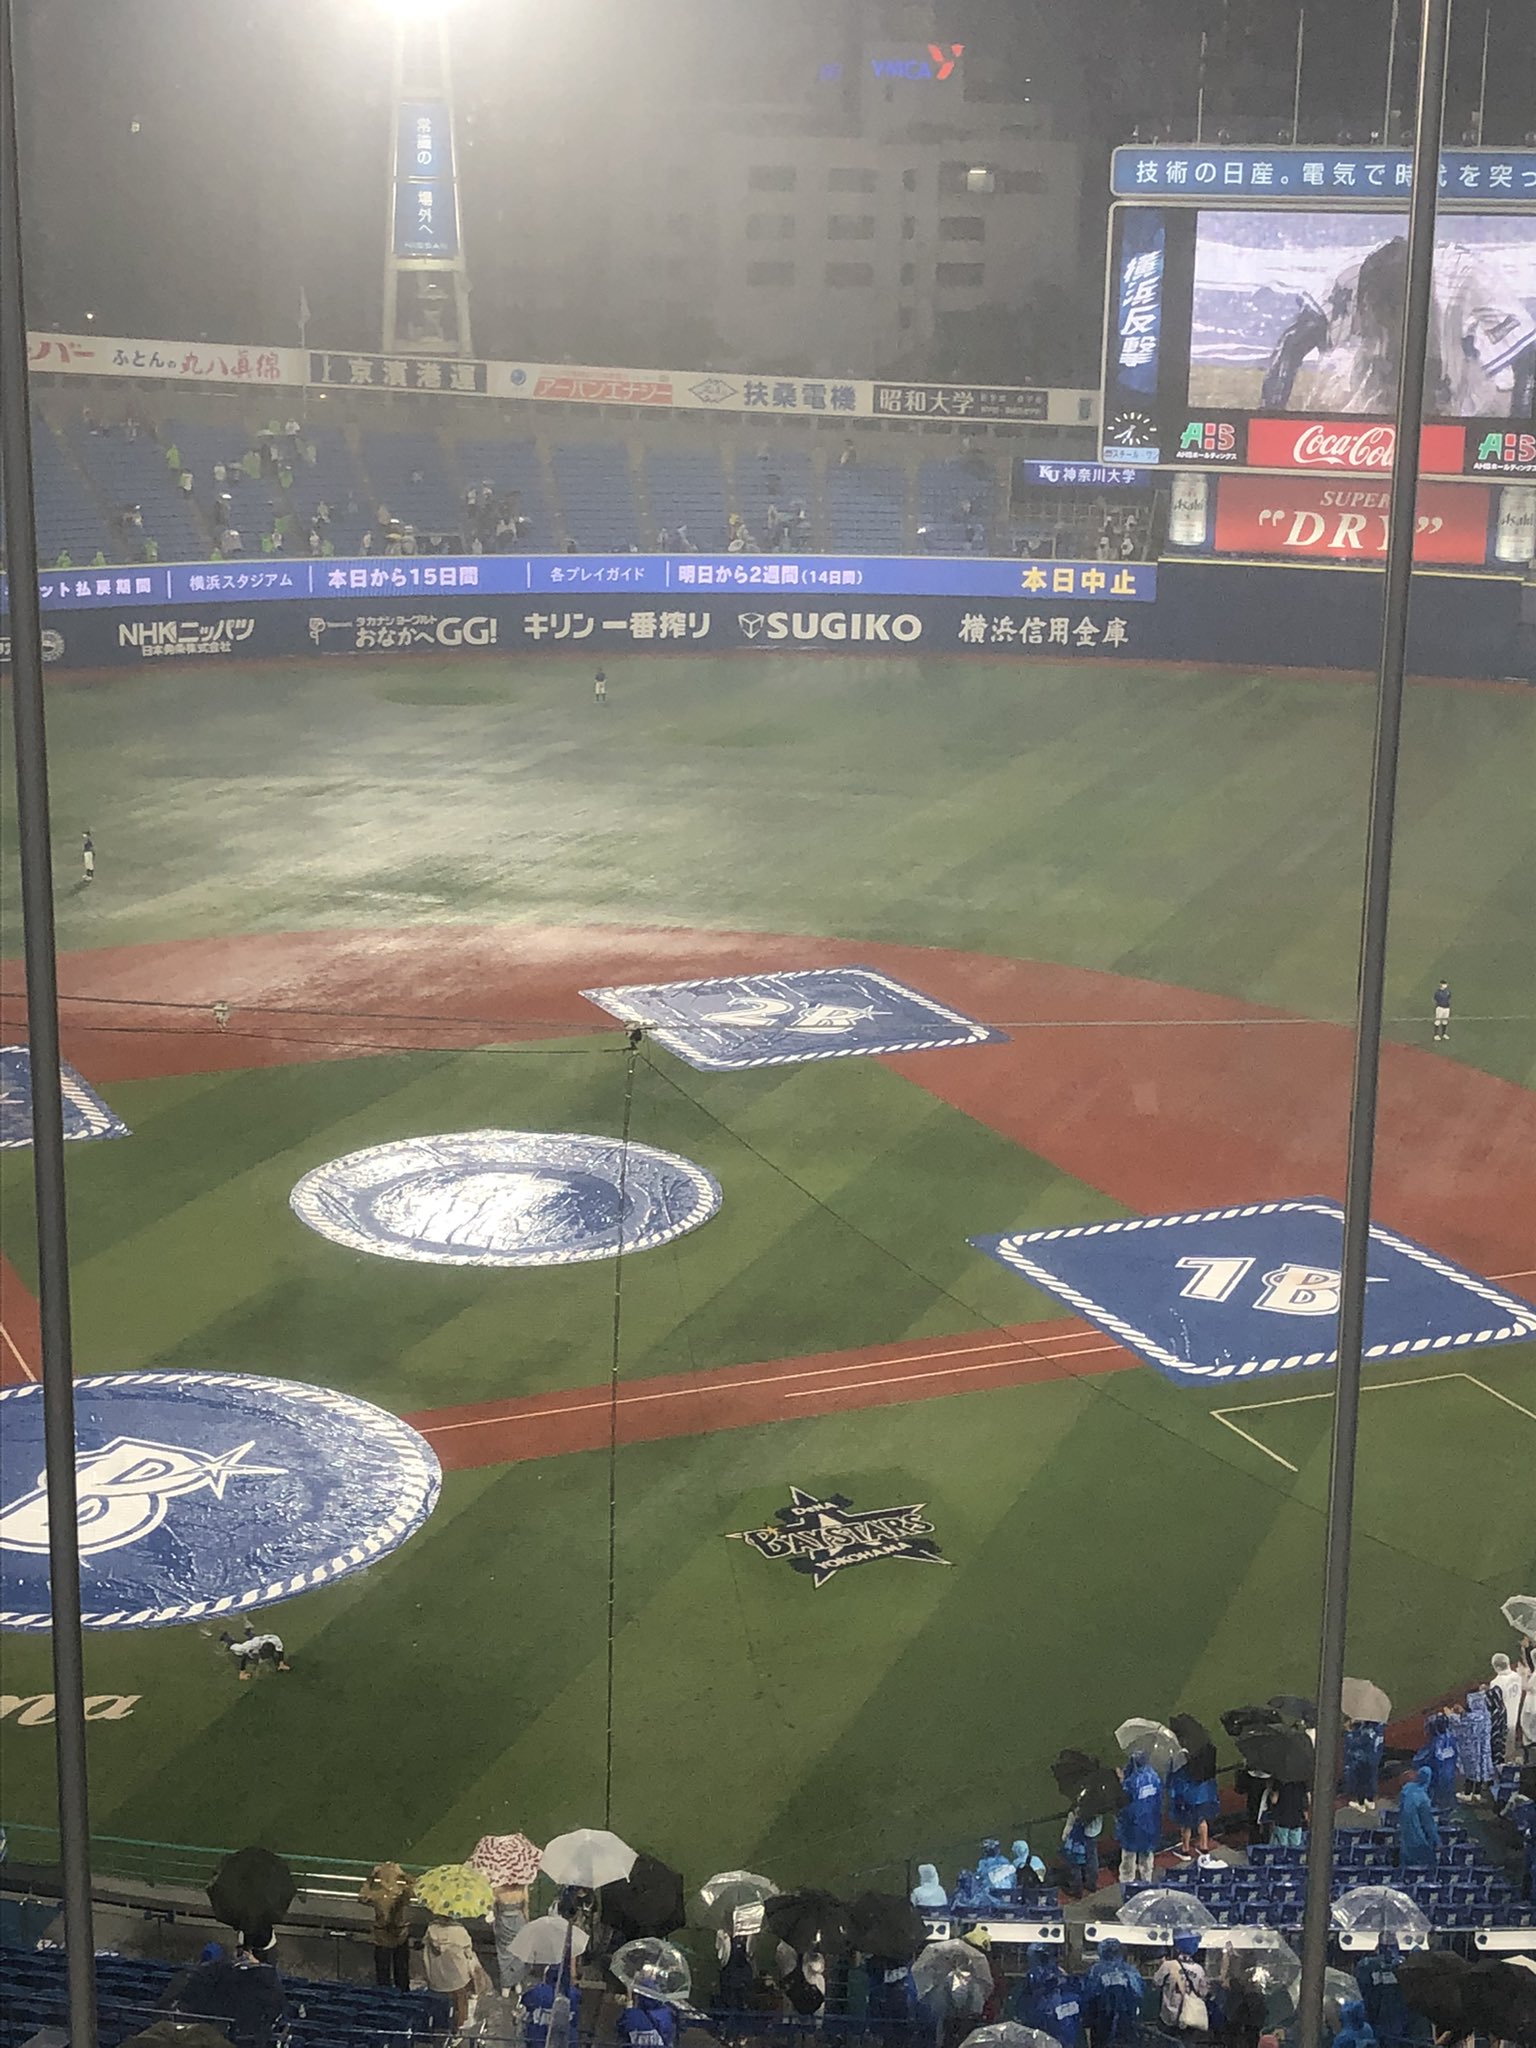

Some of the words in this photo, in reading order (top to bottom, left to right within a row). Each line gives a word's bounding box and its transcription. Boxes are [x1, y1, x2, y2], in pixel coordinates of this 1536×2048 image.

[1119, 249, 1162, 367] 横浜反撃
[743, 381, 857, 412] 扶桑電機
[878, 388, 975, 415] 昭和大学
[1063, 467, 1137, 484] 神奈川大学
[189, 573, 294, 592] 横浜スタジアム
[327, 565, 480, 590] 本日から15日間
[549, 566, 645, 583] 各プレイガイド
[1020, 566, 1137, 595] 本日中止
[118, 618, 256, 647] NHKニッパツ
[767, 612, 922, 642] SUGIKO
[956, 612, 1130, 648] 横浜信用金庫
[815, 1542, 913, 1570] YOKOHAMA
